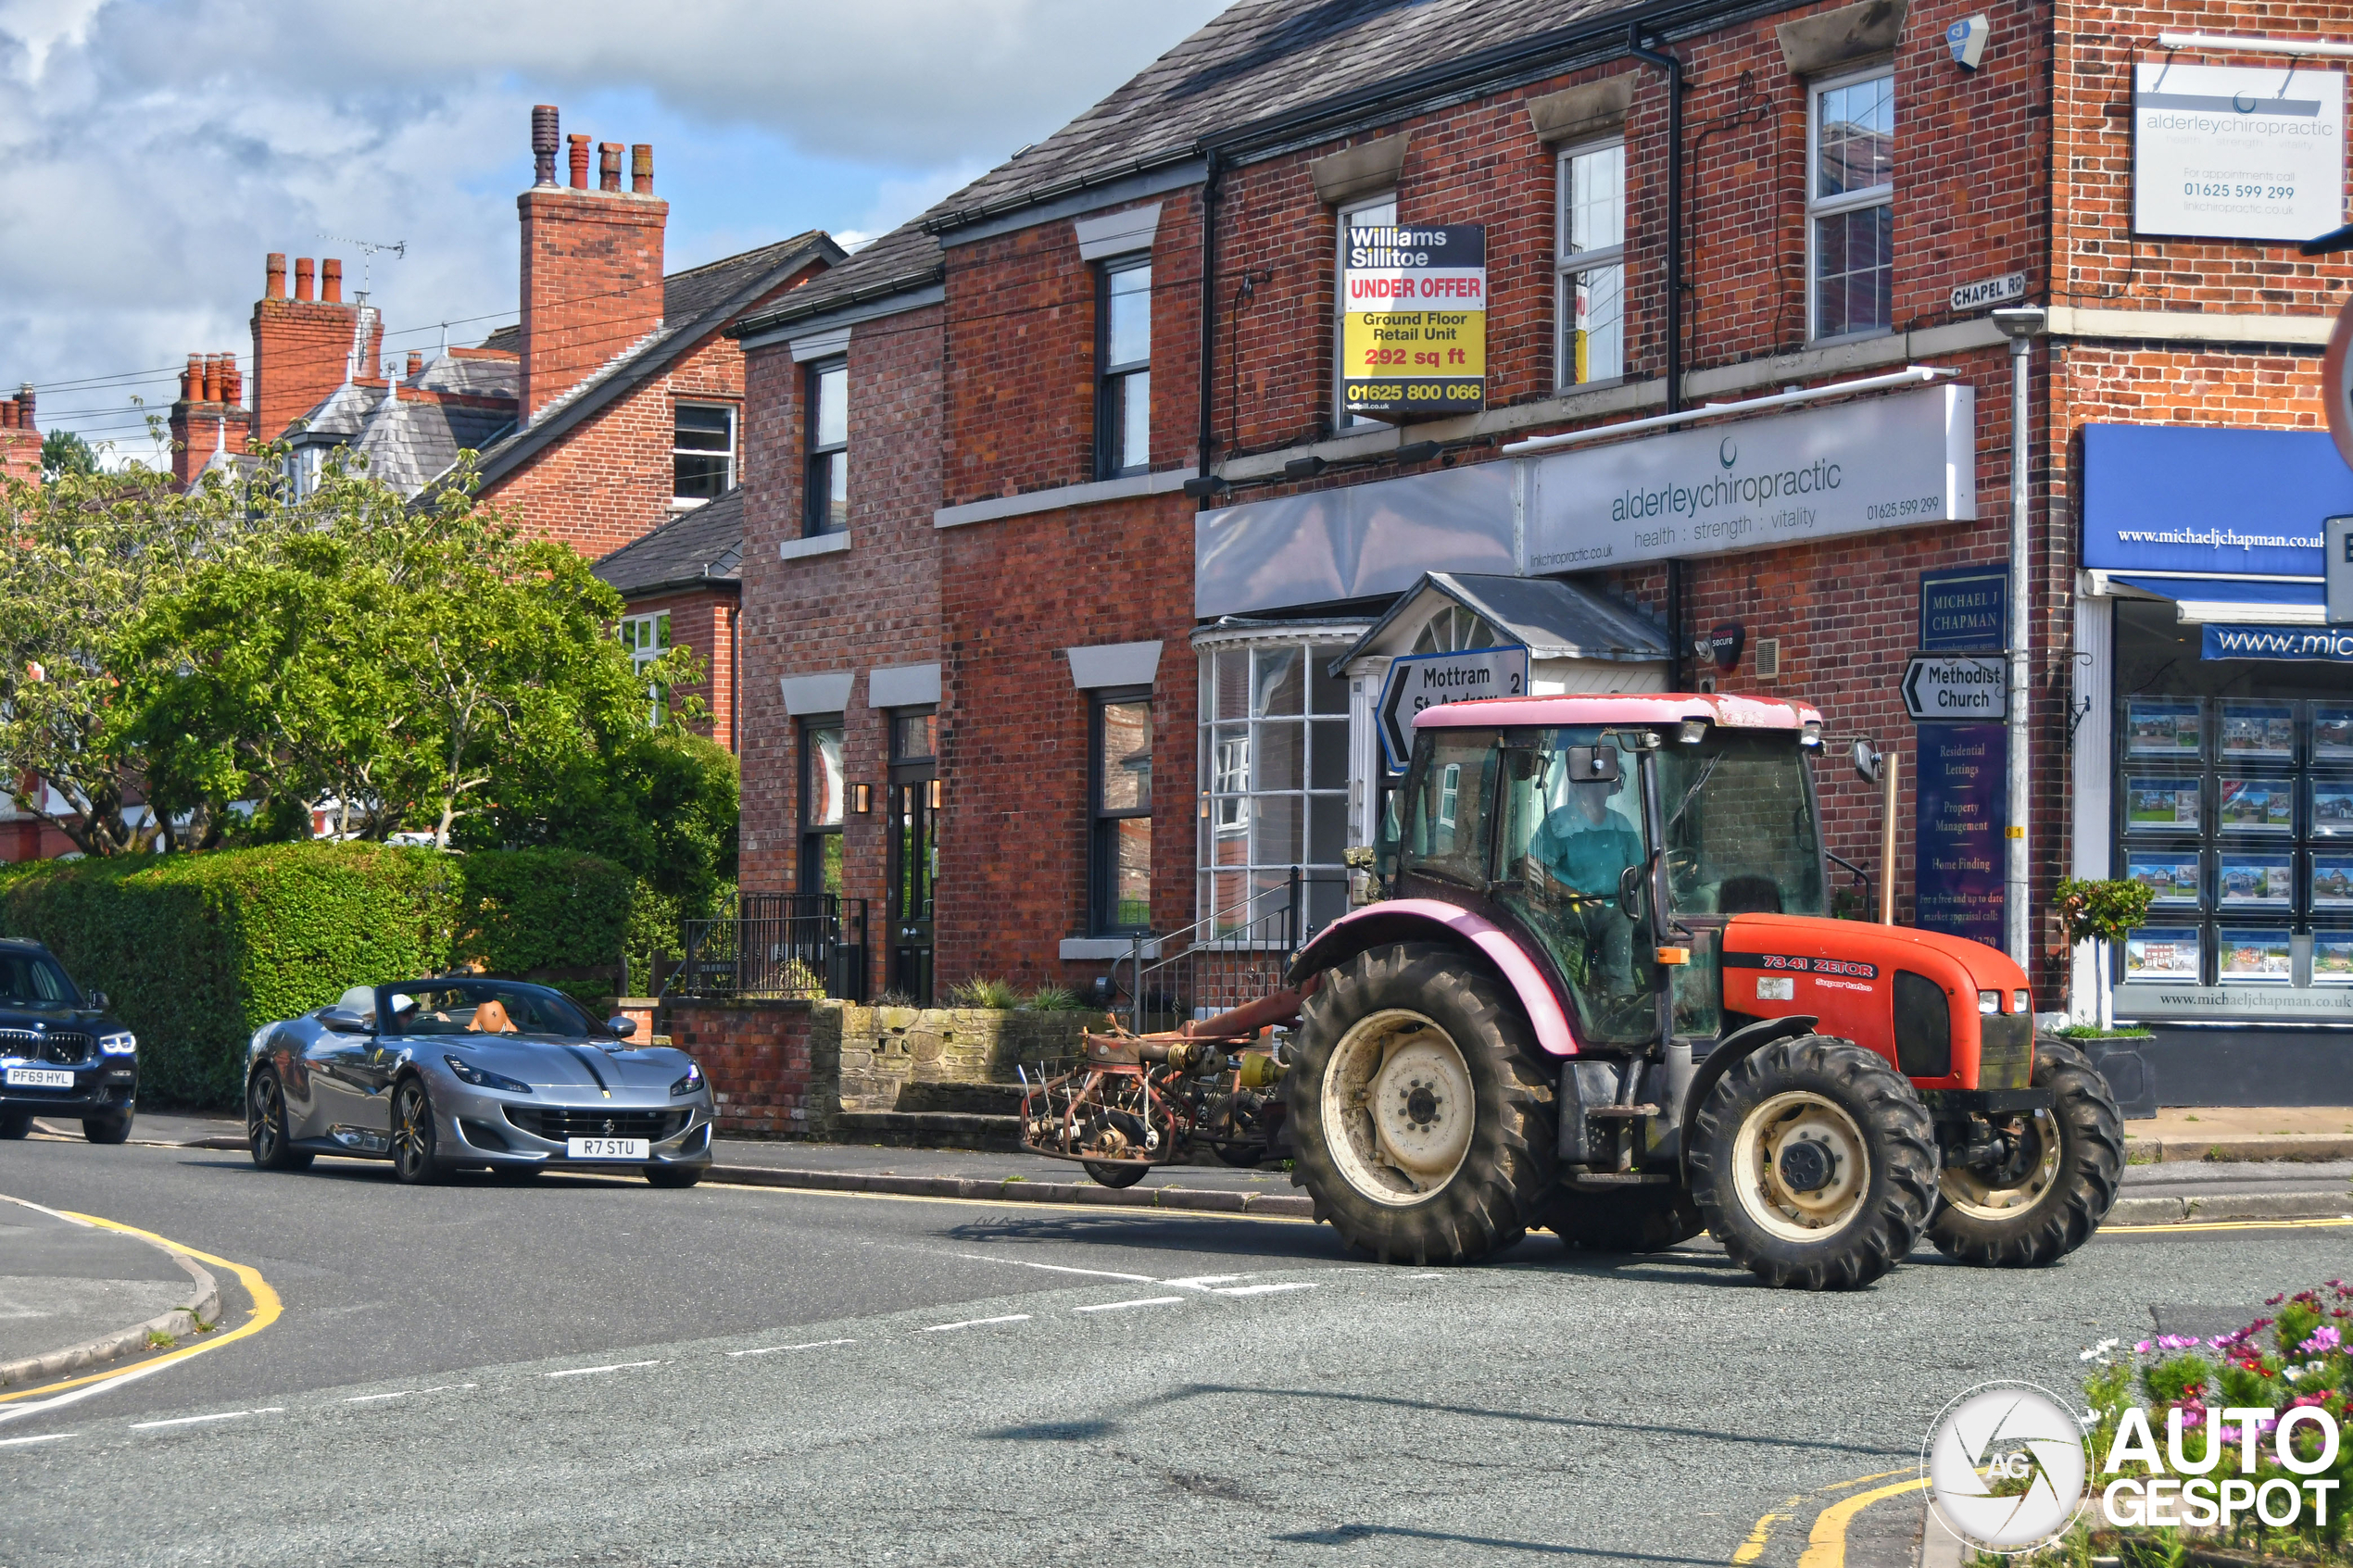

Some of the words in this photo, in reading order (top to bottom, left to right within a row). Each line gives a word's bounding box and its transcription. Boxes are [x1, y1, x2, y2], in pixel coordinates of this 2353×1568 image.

[2146, 113, 2333, 137] alderleychiropractic
[2183, 167, 2200, 178] For
[2202, 169, 2274, 182] appointments
[2276, 170, 2296, 182] call
[2183, 182, 2230, 196] 01625
[2234, 184, 2262, 198] 599
[2267, 186, 2296, 200] 299
[2183, 200, 2295, 216] linkchiropractic.co.uk
[1351, 227, 1447, 247] Williams
[1351, 247, 1429, 268] Sillitoe
[1351, 278, 1416, 298] UNDER
[1420, 277, 1481, 298] OFFER
[1954, 281, 2004, 307] CHAPEL
[1363, 313, 1422, 326] Ground
[1427, 313, 1467, 326] Floor
[1373, 328, 1418, 341] Retail
[1424, 328, 1457, 341] Unit
[1365, 348, 1407, 365] 292
[1414, 351, 1440, 369] sq
[1447, 347, 1466, 365] ft
[1348, 384, 1403, 401] 01625
[1406, 384, 1442, 401] 800
[1445, 384, 1481, 401] 066
[1612, 458, 1843, 522] alderleychiropractic
[1867, 502, 1897, 521] 01625
[1899, 499, 1918, 516] 599
[1920, 496, 1939, 513] 299
[1634, 526, 1676, 548] health
[1693, 514, 1753, 540] strength
[1770, 507, 1817, 528] vitality
[1529, 543, 1613, 568] linkchiropractic.co.uk
[1932, 592, 1988, 610] MICHAEL
[1992, 591, 1998, 605] J
[1932, 612, 1997, 632] CHAPMAN
[1712, 636, 1733, 647] secure
[1423, 666, 1491, 689] Mottram
[1510, 672, 1520, 695] 2
[1929, 666, 2001, 684] Methodist
[1937, 689, 1990, 709] Church
[1940, 743, 1985, 758] Residential
[1945, 763, 1979, 778] Lettings
[1944, 801, 1980, 816] Property
[1935, 820, 1988, 835] Management
[1932, 859, 1957, 870] Home
[1958, 857, 1991, 873] Finding
[1919, 893, 1931, 904] For
[1938, 892, 1952, 904] free
[1953, 893, 1966, 904] and
[1968, 896, 1977, 907] up
[1979, 895, 1986, 903] to
[1987, 892, 2004, 903] date
[1924, 910, 1948, 922] market
[1949, 909, 1982, 924] appraisal
[1982, 909, 1998, 922] call:
[1813, 960, 1873, 977] ZETOR
[2159, 992, 2353, 1010] www.michaeljchapman.co.uk
[12, 1071, 44, 1083] PF69
[46, 1072, 69, 1085] HYL
[584, 1140, 603, 1154] R7
[607, 1140, 635, 1155] STU
